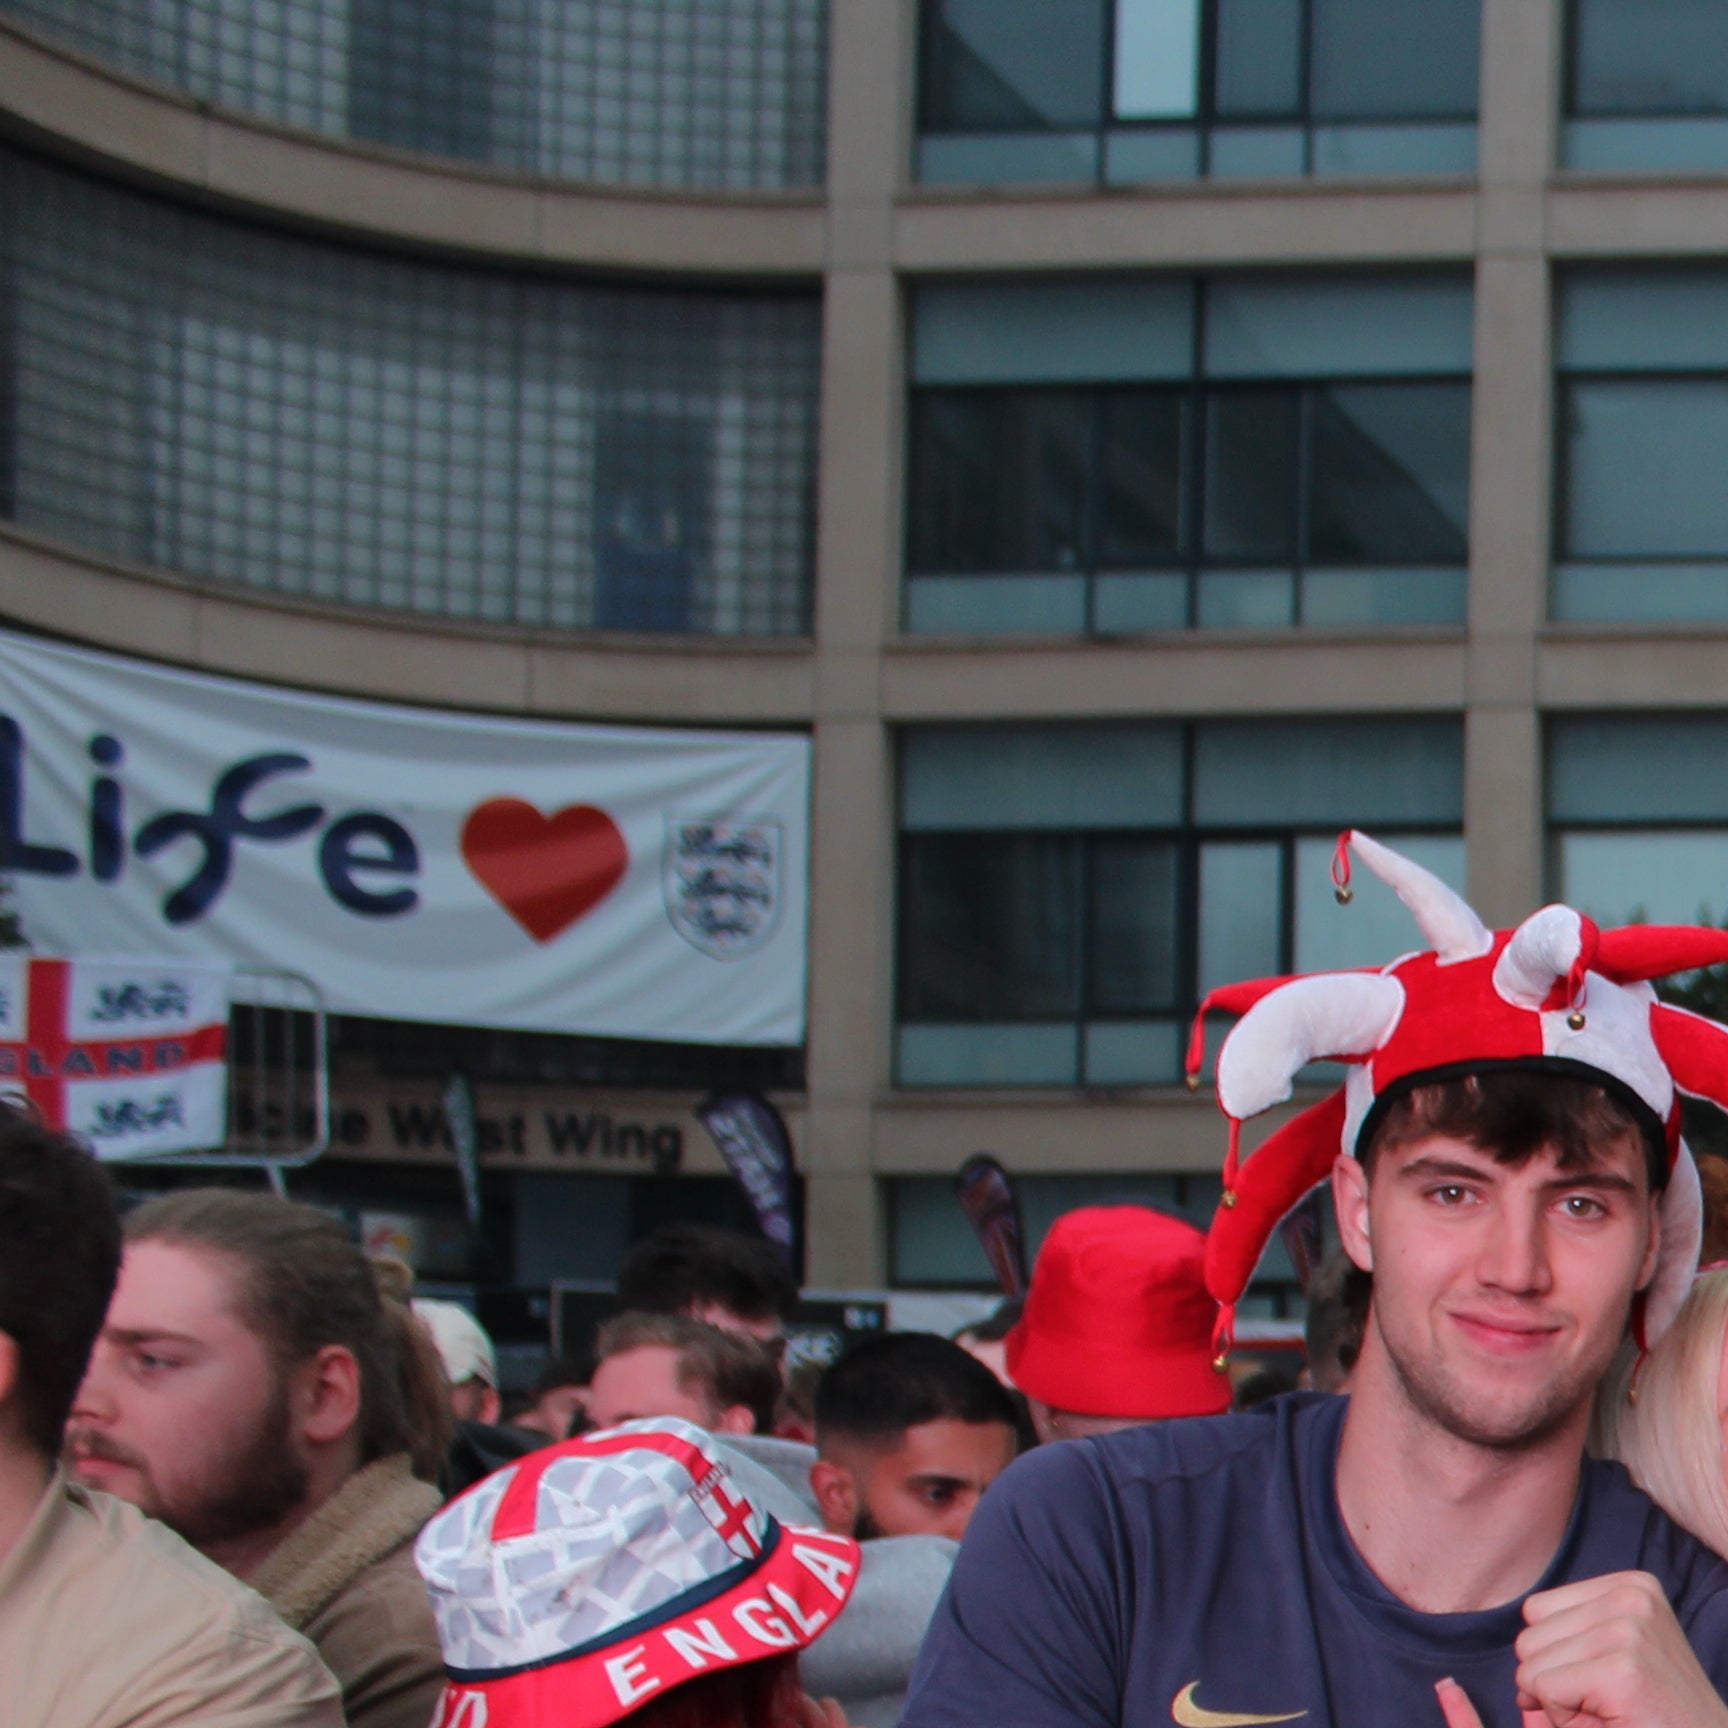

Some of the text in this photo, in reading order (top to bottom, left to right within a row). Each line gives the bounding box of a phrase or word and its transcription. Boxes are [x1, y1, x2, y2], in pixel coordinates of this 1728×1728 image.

[0, 714, 421, 925] Life
[388, 1103, 525, 1154] Wst
[544, 1108, 681, 1176] Wing
